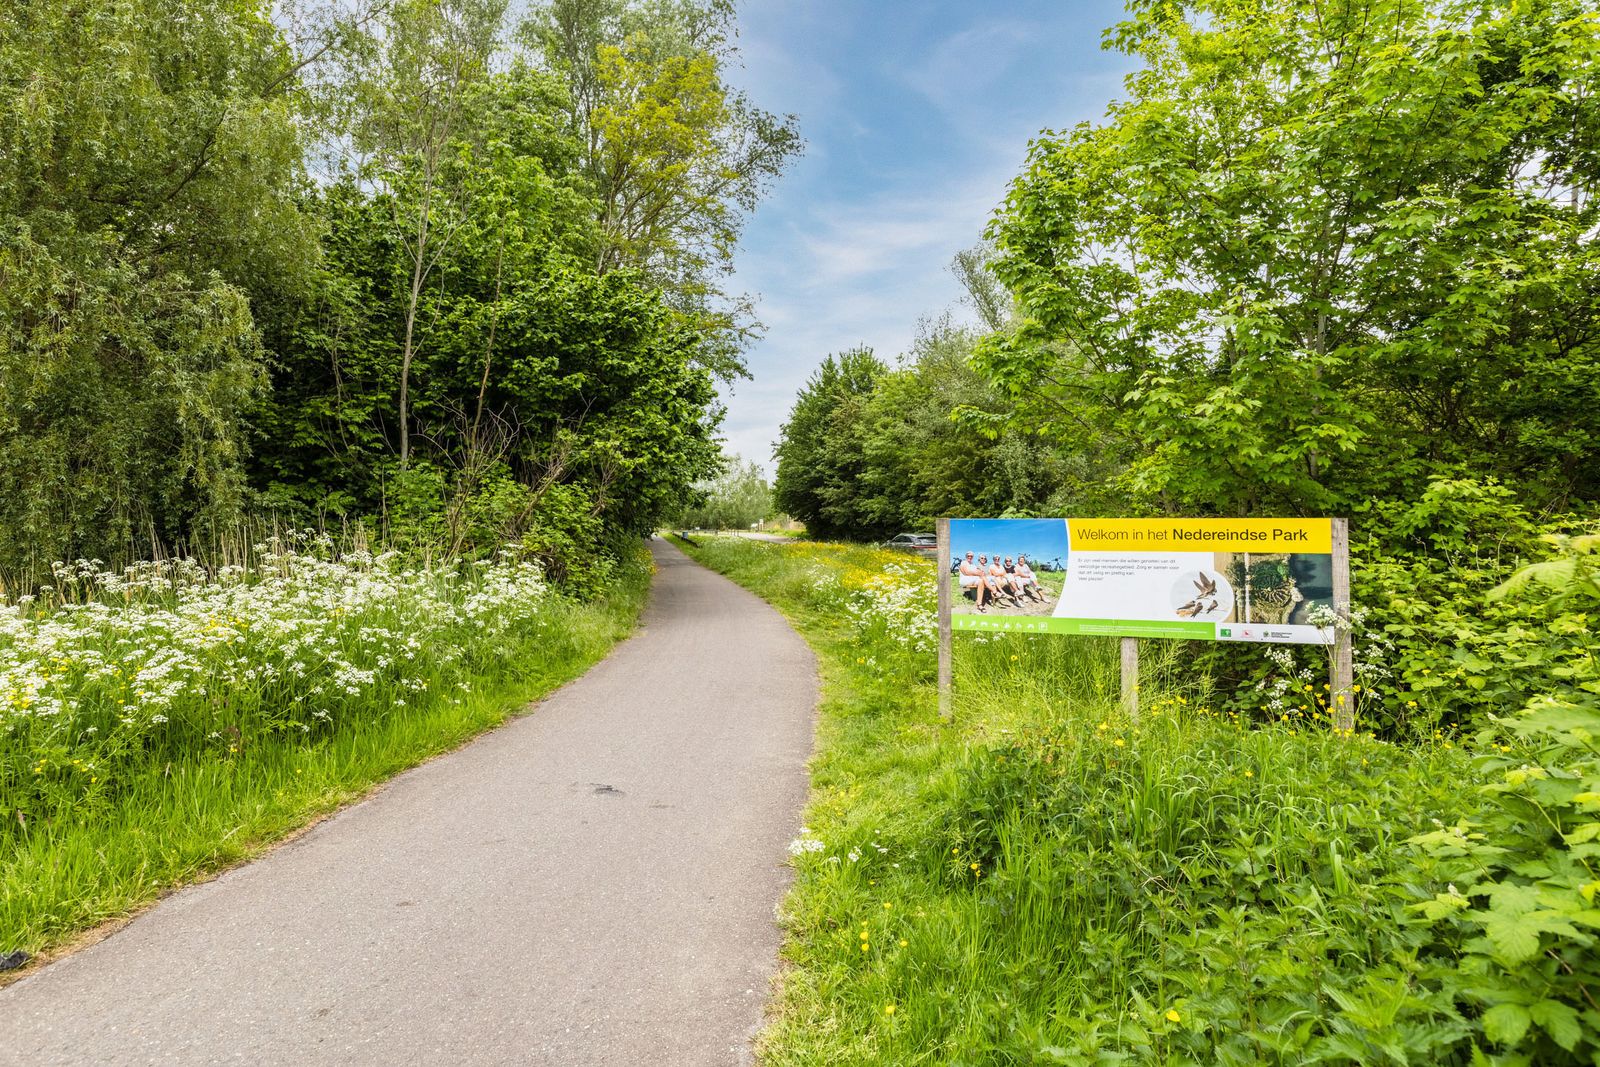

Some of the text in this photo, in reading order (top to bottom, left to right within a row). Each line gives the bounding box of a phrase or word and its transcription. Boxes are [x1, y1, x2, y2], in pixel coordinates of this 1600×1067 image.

[1077, 528, 1309, 541] Welkom in het Nedereindse Park
